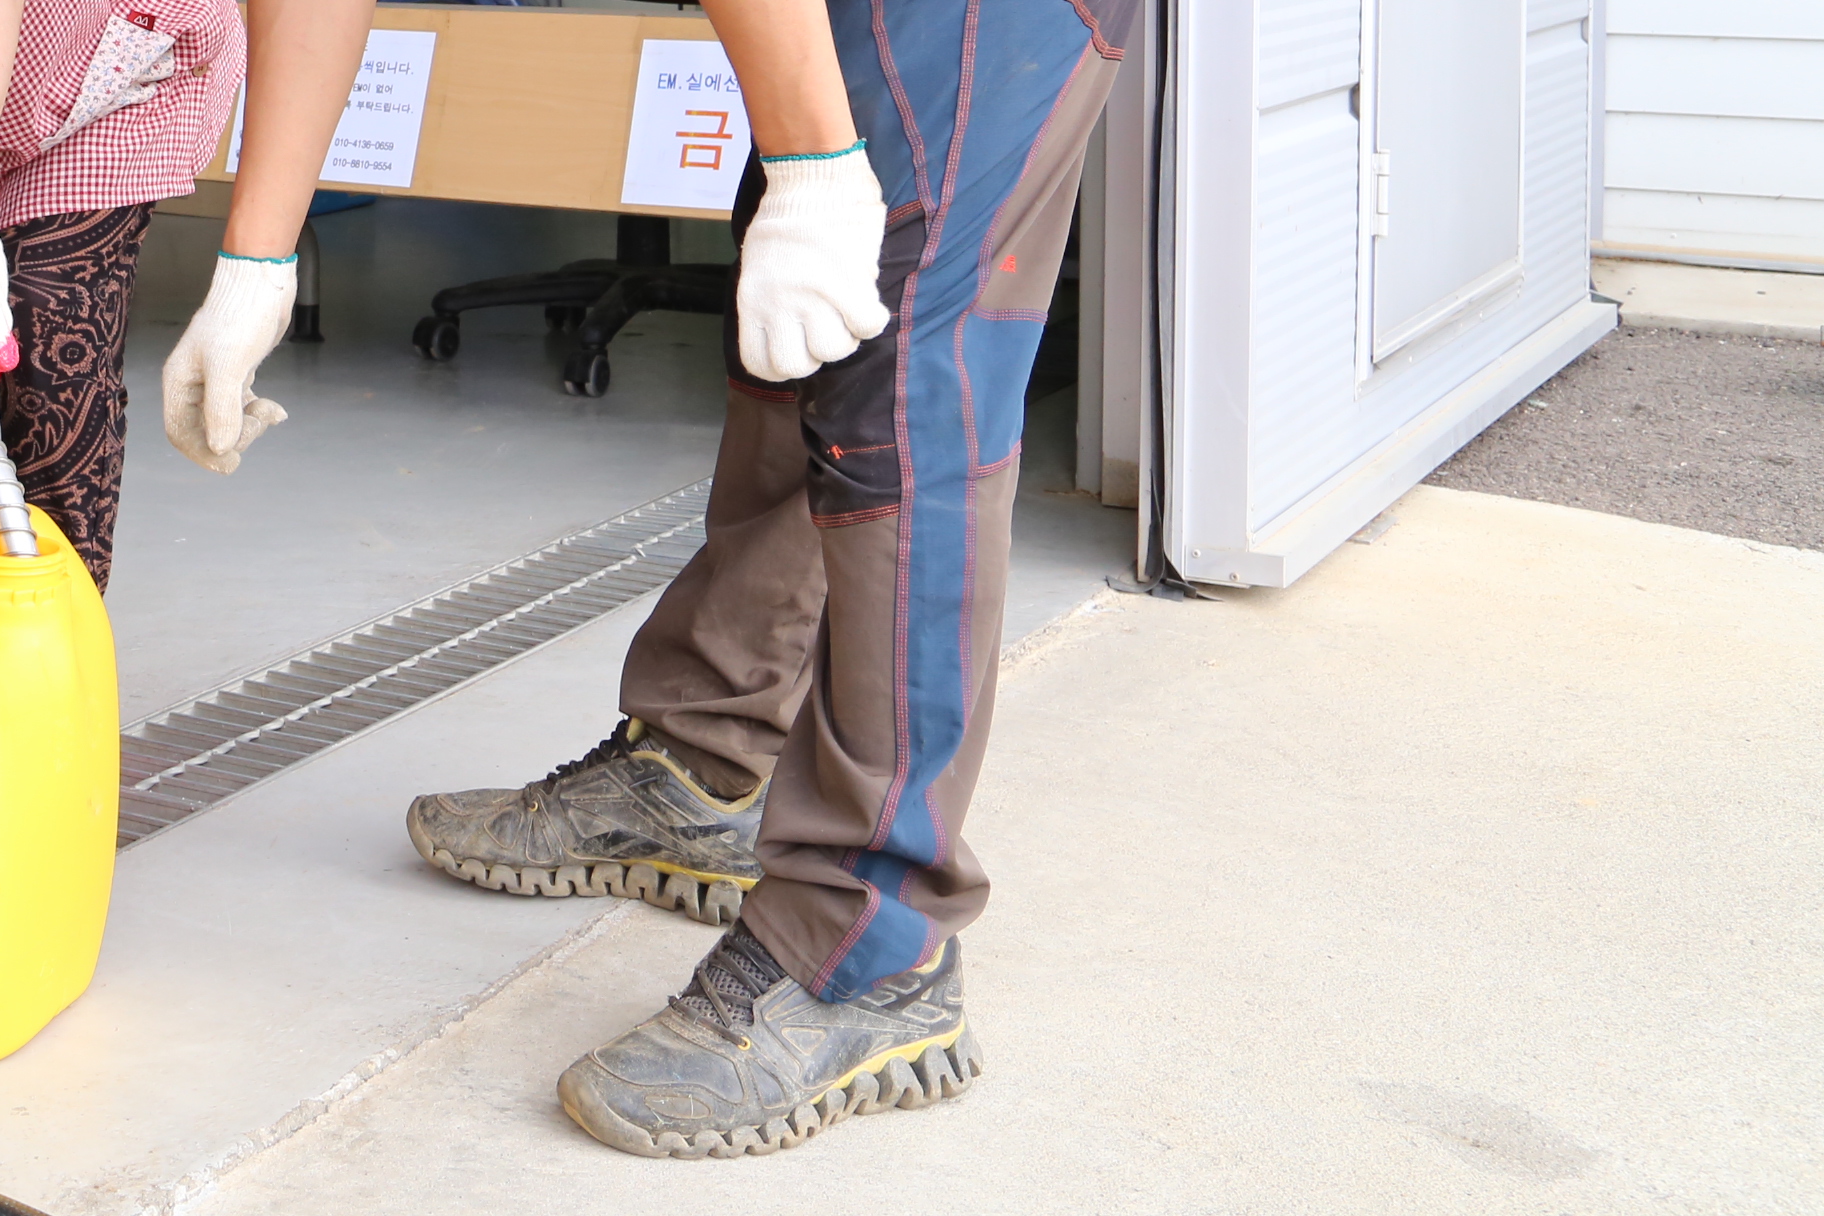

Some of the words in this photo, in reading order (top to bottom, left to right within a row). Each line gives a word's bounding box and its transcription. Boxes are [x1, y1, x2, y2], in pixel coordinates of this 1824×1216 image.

[358, 60, 414, 75] 씩입니다.
[375, 84, 393, 95] 없어
[356, 100, 414, 114] 부탁드립니다.
[334, 137, 394, 151] 010-4136-0659
[675, 109, 733, 171] 금
[332, 157, 392, 171] 010-8810-9554
